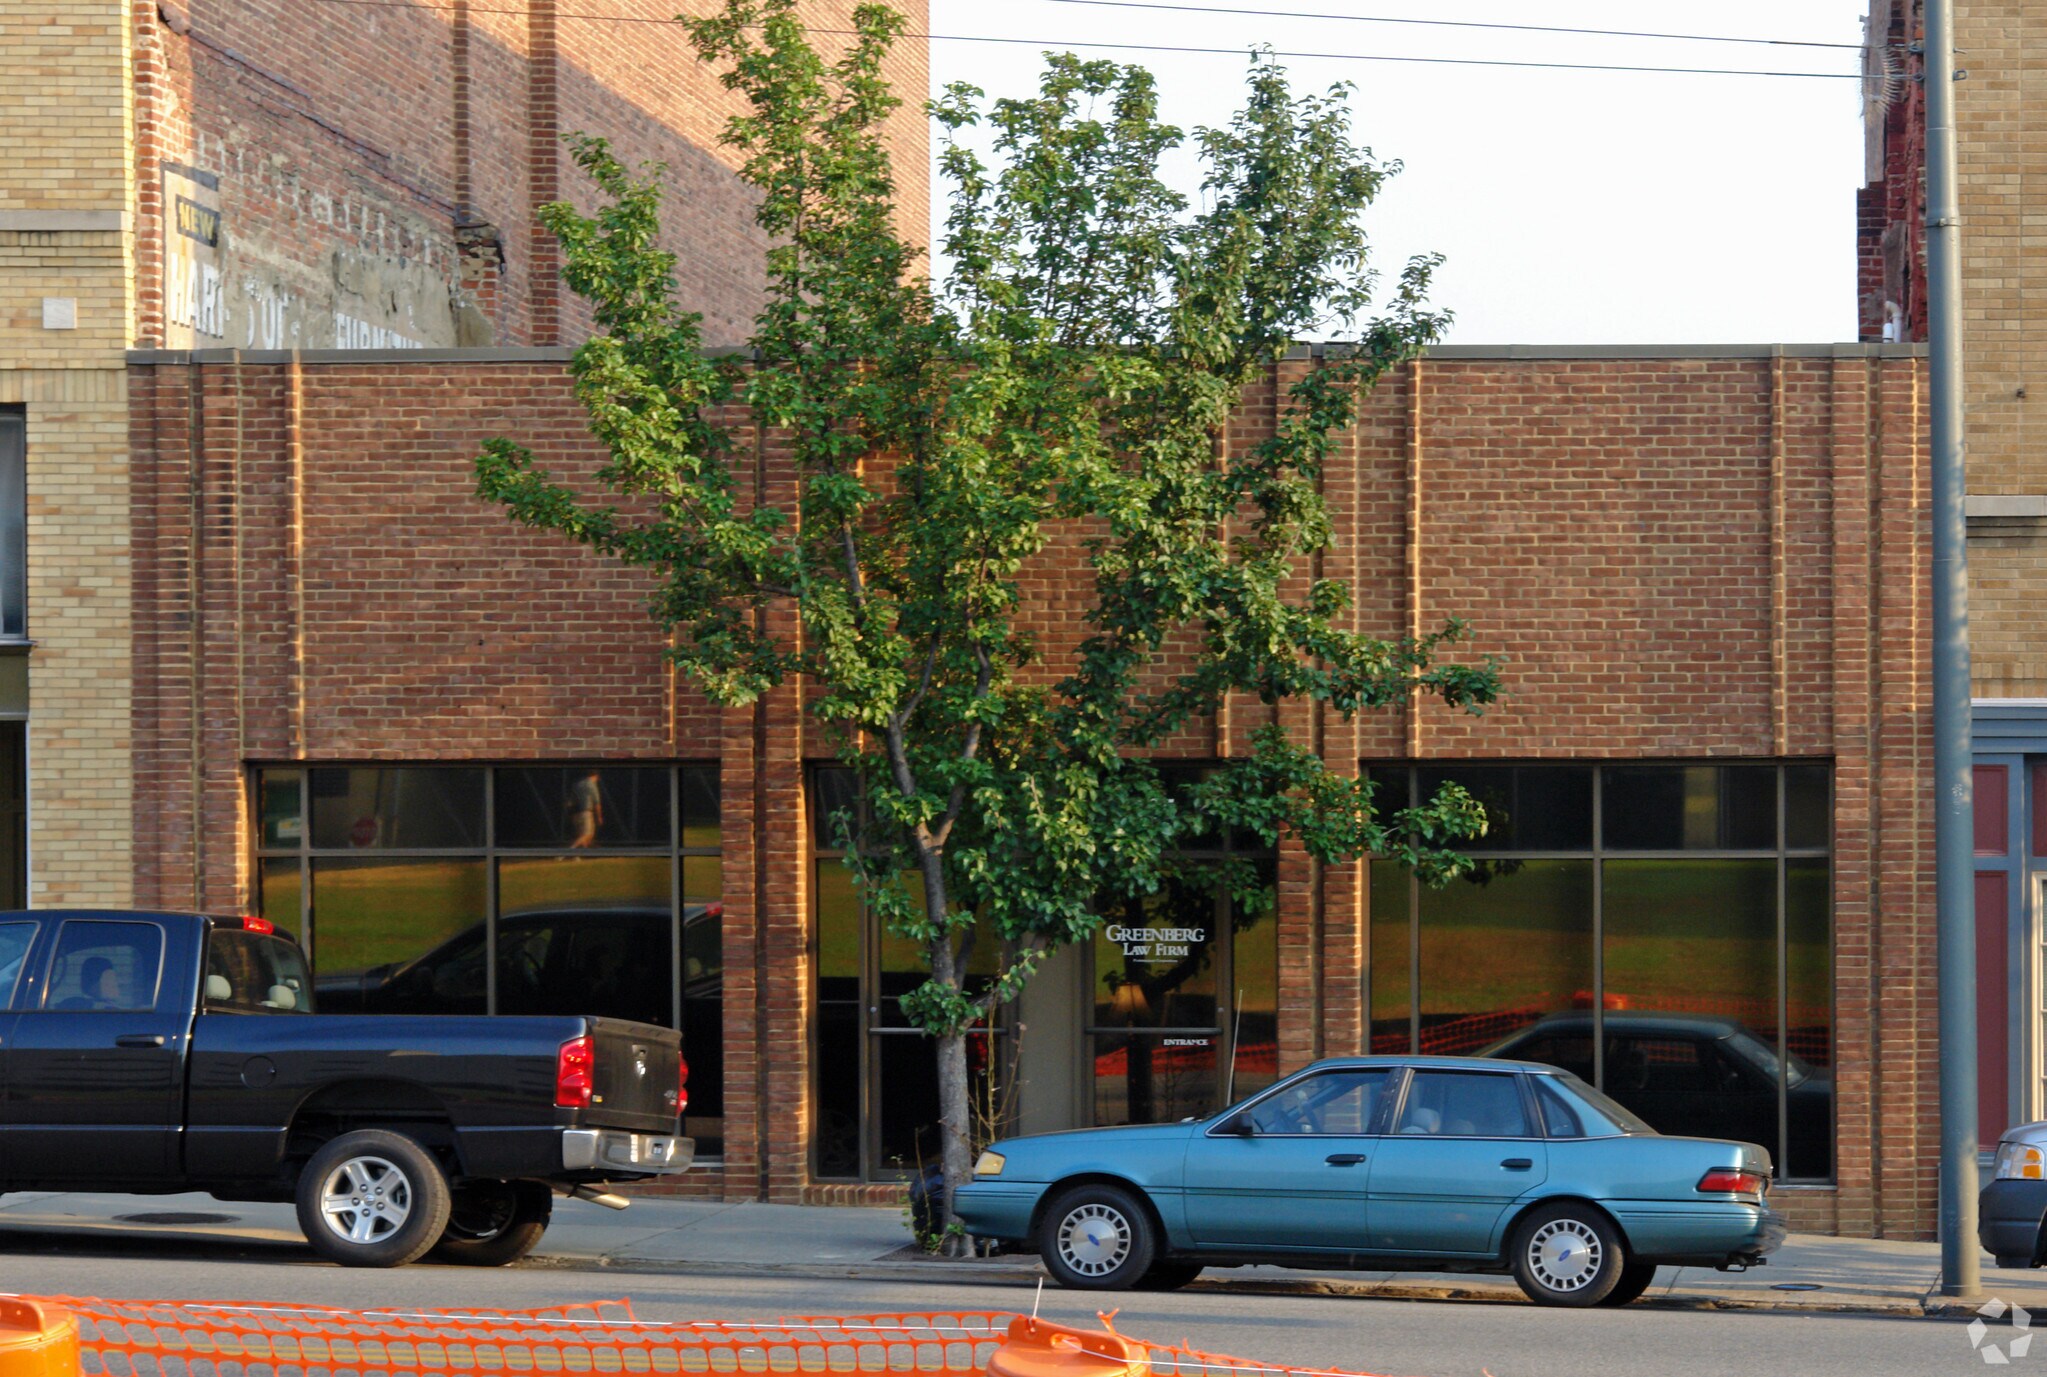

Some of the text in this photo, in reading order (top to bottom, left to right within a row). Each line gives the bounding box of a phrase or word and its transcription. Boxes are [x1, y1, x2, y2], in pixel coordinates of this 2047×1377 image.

[178, 202, 215, 240] NEW
[1105, 924, 1205, 942] GREENBERG
[1122, 942, 1189, 956] LAW FIRM
